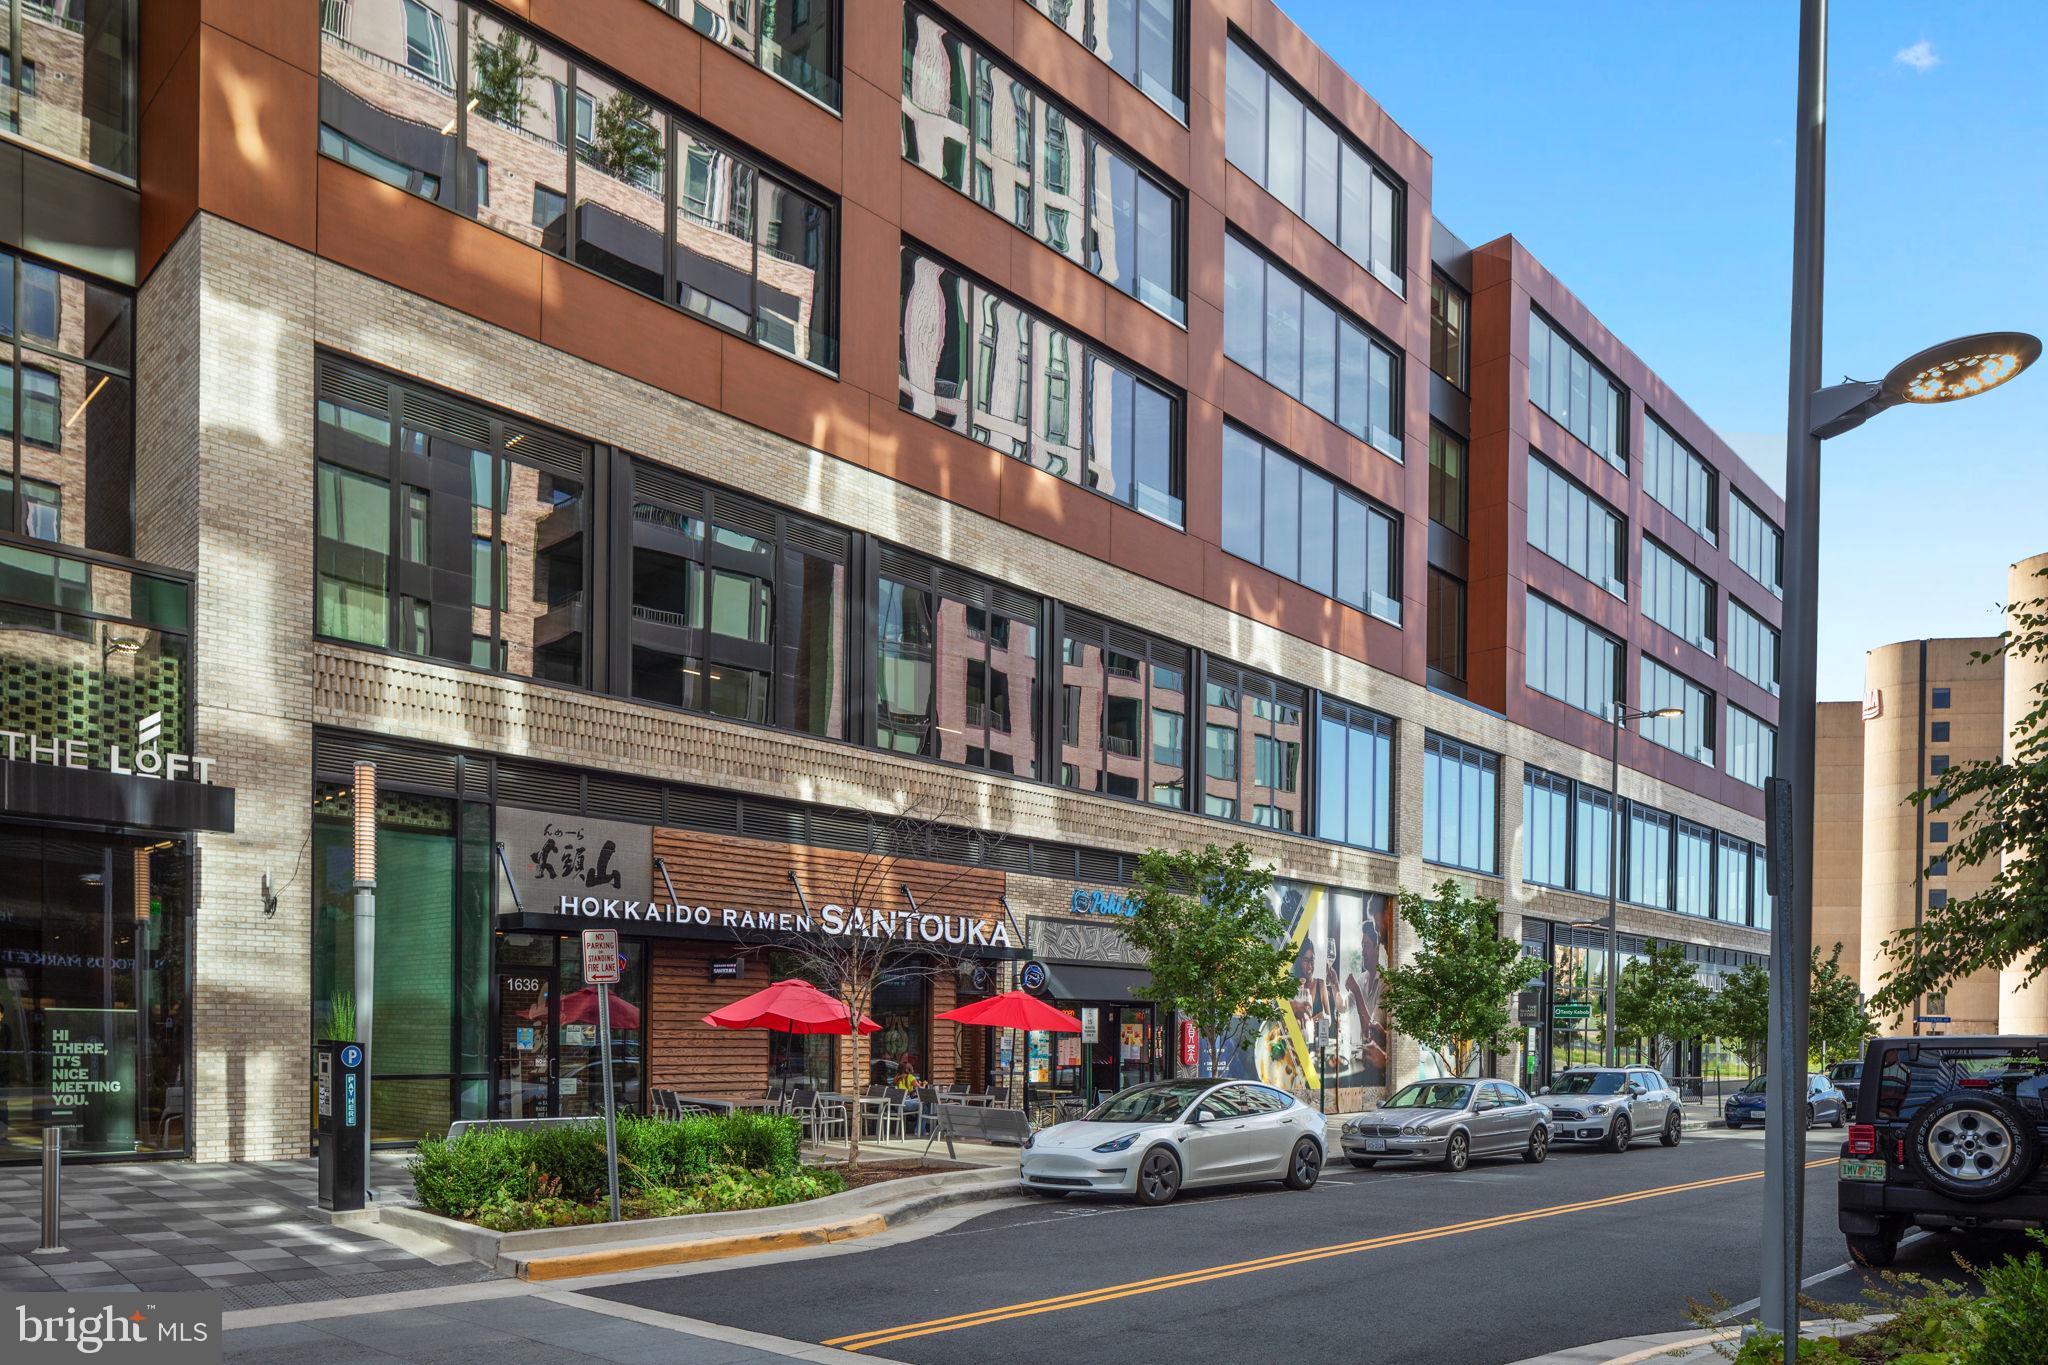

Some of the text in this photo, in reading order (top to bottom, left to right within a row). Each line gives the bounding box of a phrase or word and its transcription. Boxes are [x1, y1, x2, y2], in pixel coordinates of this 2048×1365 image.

[0, 730, 217, 785] THE LOFT
[559, 895, 1011, 948] HOKKAIDO RAMEN SANTOUKA
[595, 933, 605, 941] NO
[586, 942, 615, 950] PARKING
[587, 954, 615, 962] STANDING
[587, 963, 600, 972] FIRE
[601, 963, 616, 972] LANE
[507, 978, 539, 991] 1636
[52, 1029, 70, 1041] HI
[52, 1042, 109, 1056] THERE,
[52, 1055, 82, 1067] IT'S
[348, 1049, 358, 1064] P
[52, 1068, 90, 1080] NICE
[52, 1081, 121, 1093] MEETING
[52, 1094, 90, 1106] YOU.
[347, 1076, 355, 1124] PAY HERE
